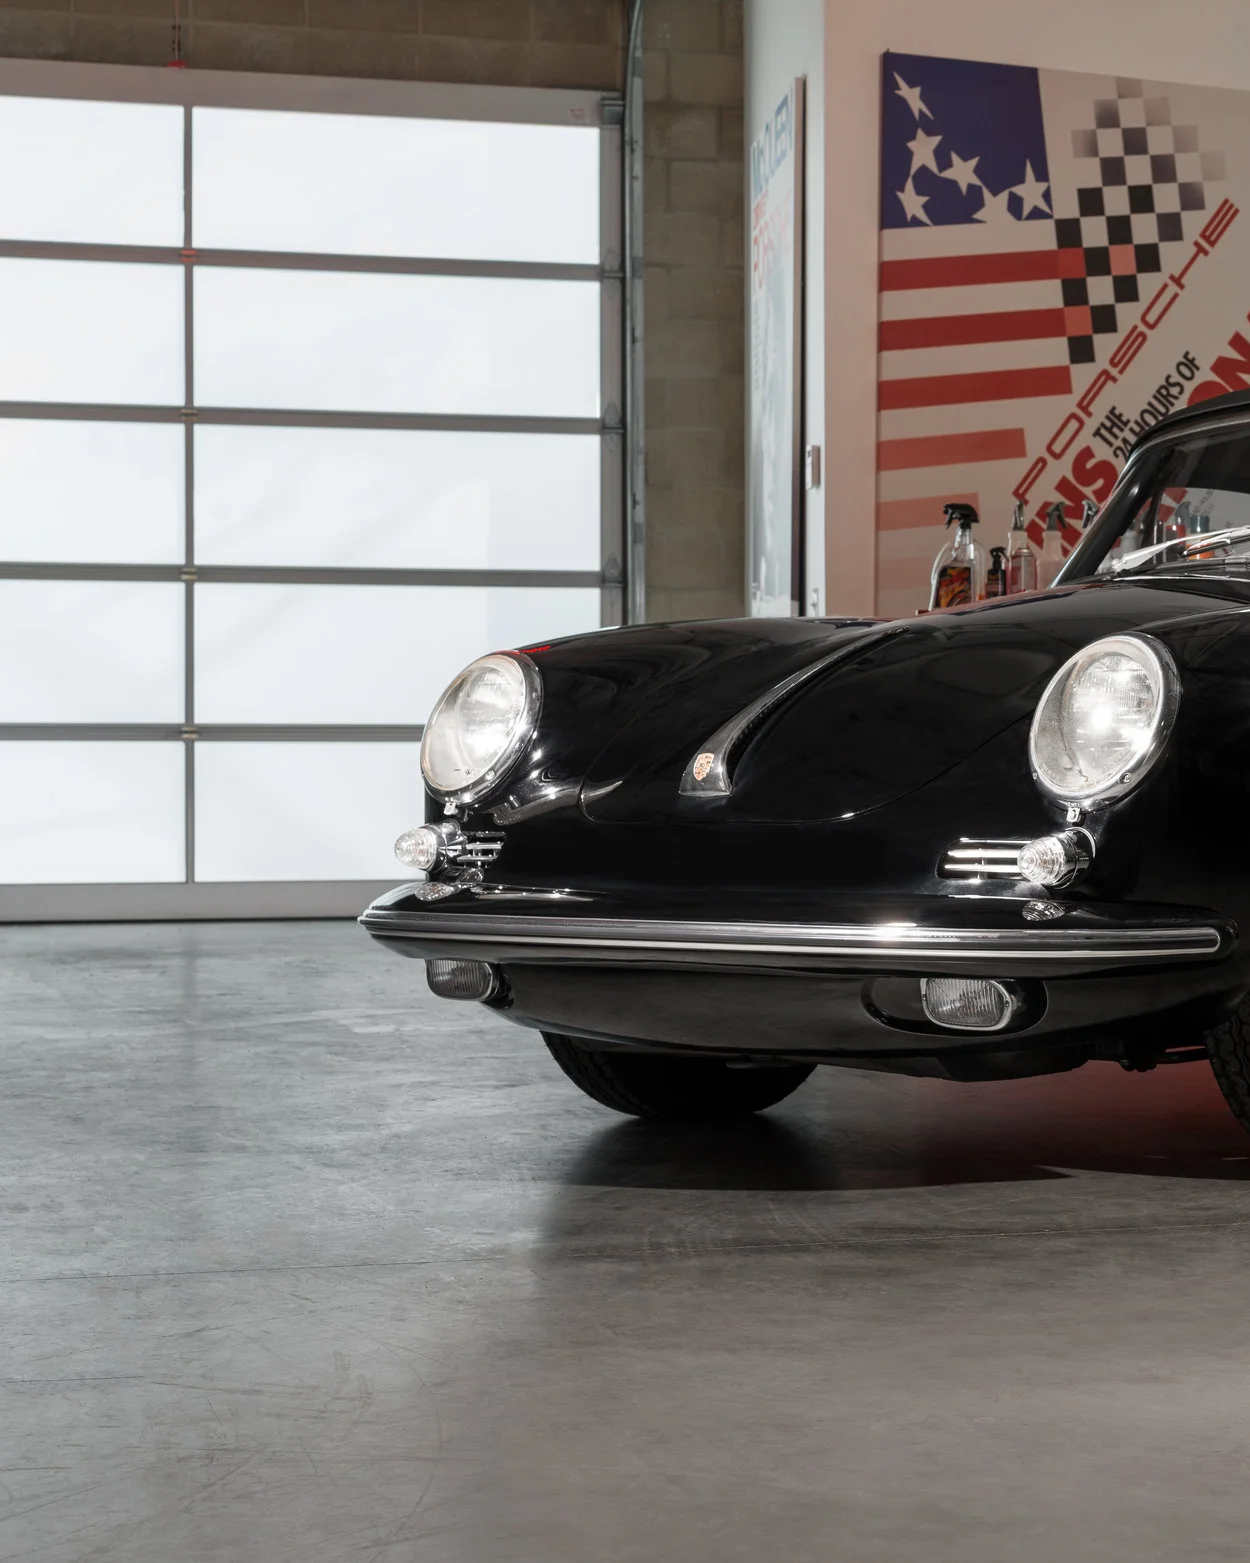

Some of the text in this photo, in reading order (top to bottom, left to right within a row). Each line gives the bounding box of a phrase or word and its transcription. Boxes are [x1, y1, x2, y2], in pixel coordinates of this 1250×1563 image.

[1012, 198, 1240, 507] PORSCHE
[1131, 374, 1186, 440] HOURS
[1176, 350, 1201, 381] OF
[1092, 405, 1132, 448] THE
